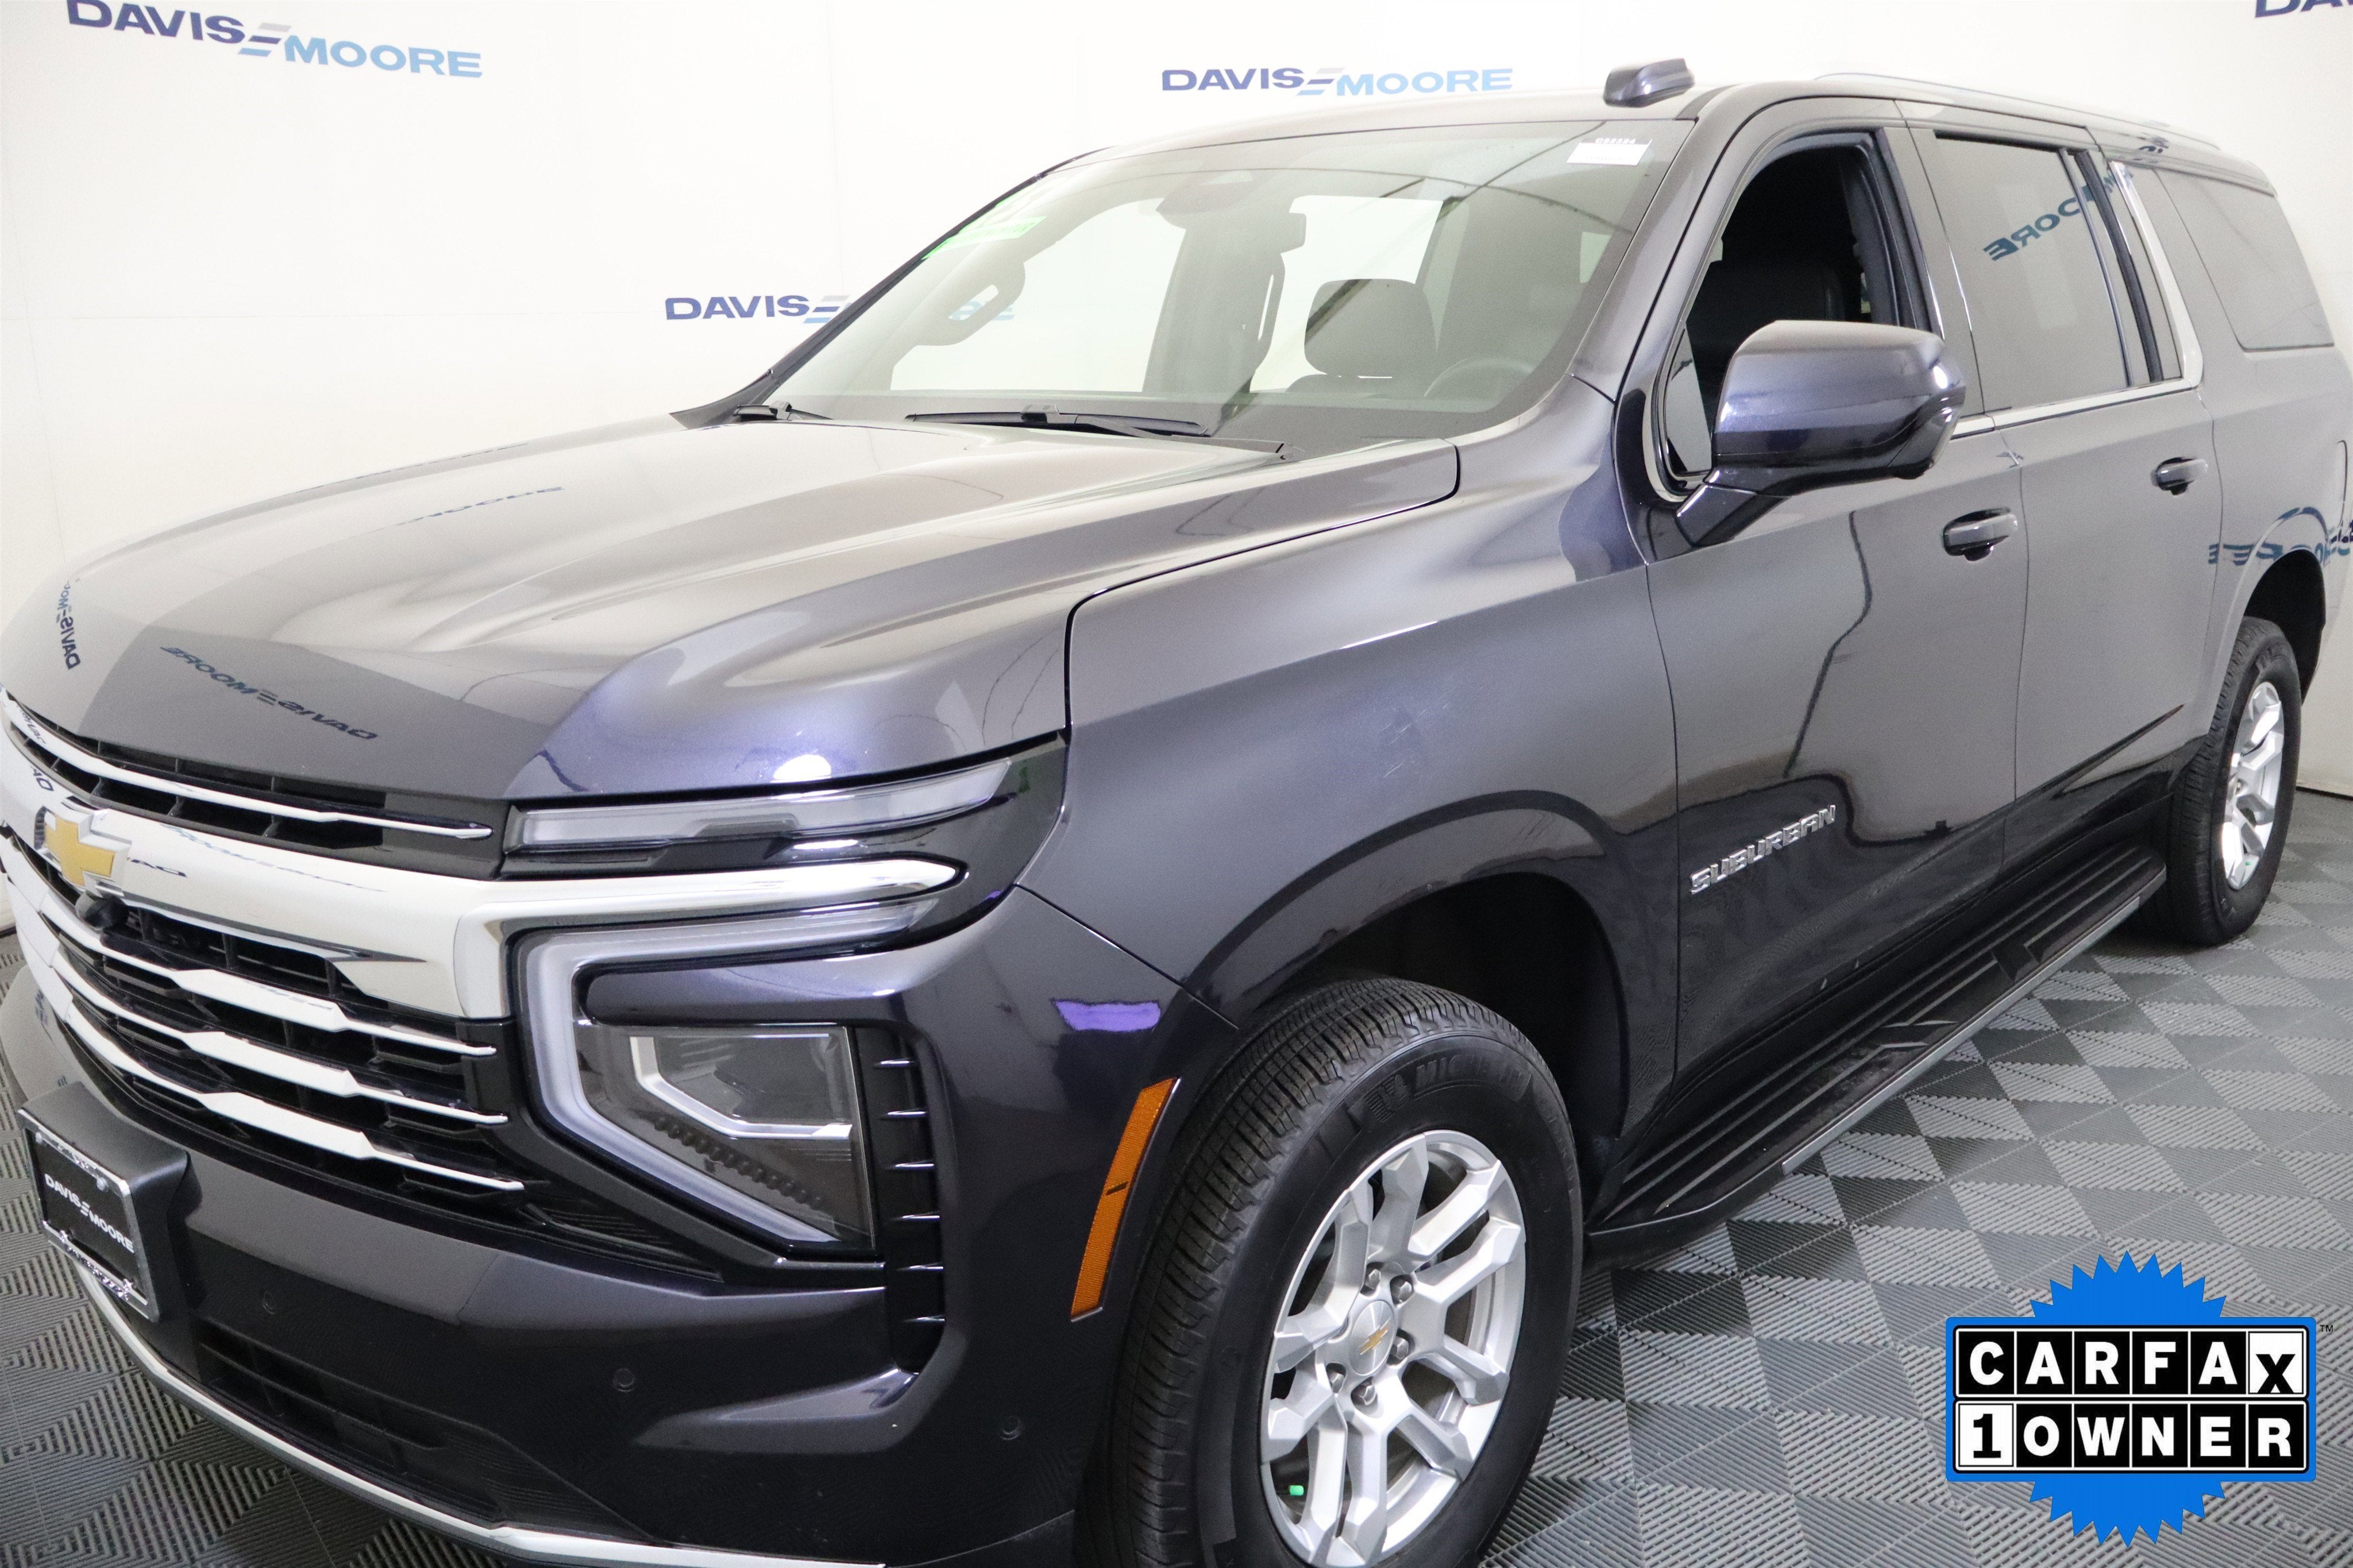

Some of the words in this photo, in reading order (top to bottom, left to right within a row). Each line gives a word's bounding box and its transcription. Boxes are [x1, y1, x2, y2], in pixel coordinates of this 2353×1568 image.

[66, 0, 246, 44] DAVIS
[284, 35, 483, 78] MOORE
[1162, 67, 1305, 91] DAVIS
[1336, 68, 1514, 96] MOORE
[665, 295, 810, 320] DAVIS
[1689, 804, 1836, 895] SUBURBAN
[44, 1173, 81, 1211] DAVIS
[89, 1213, 134, 1254] MOORE
